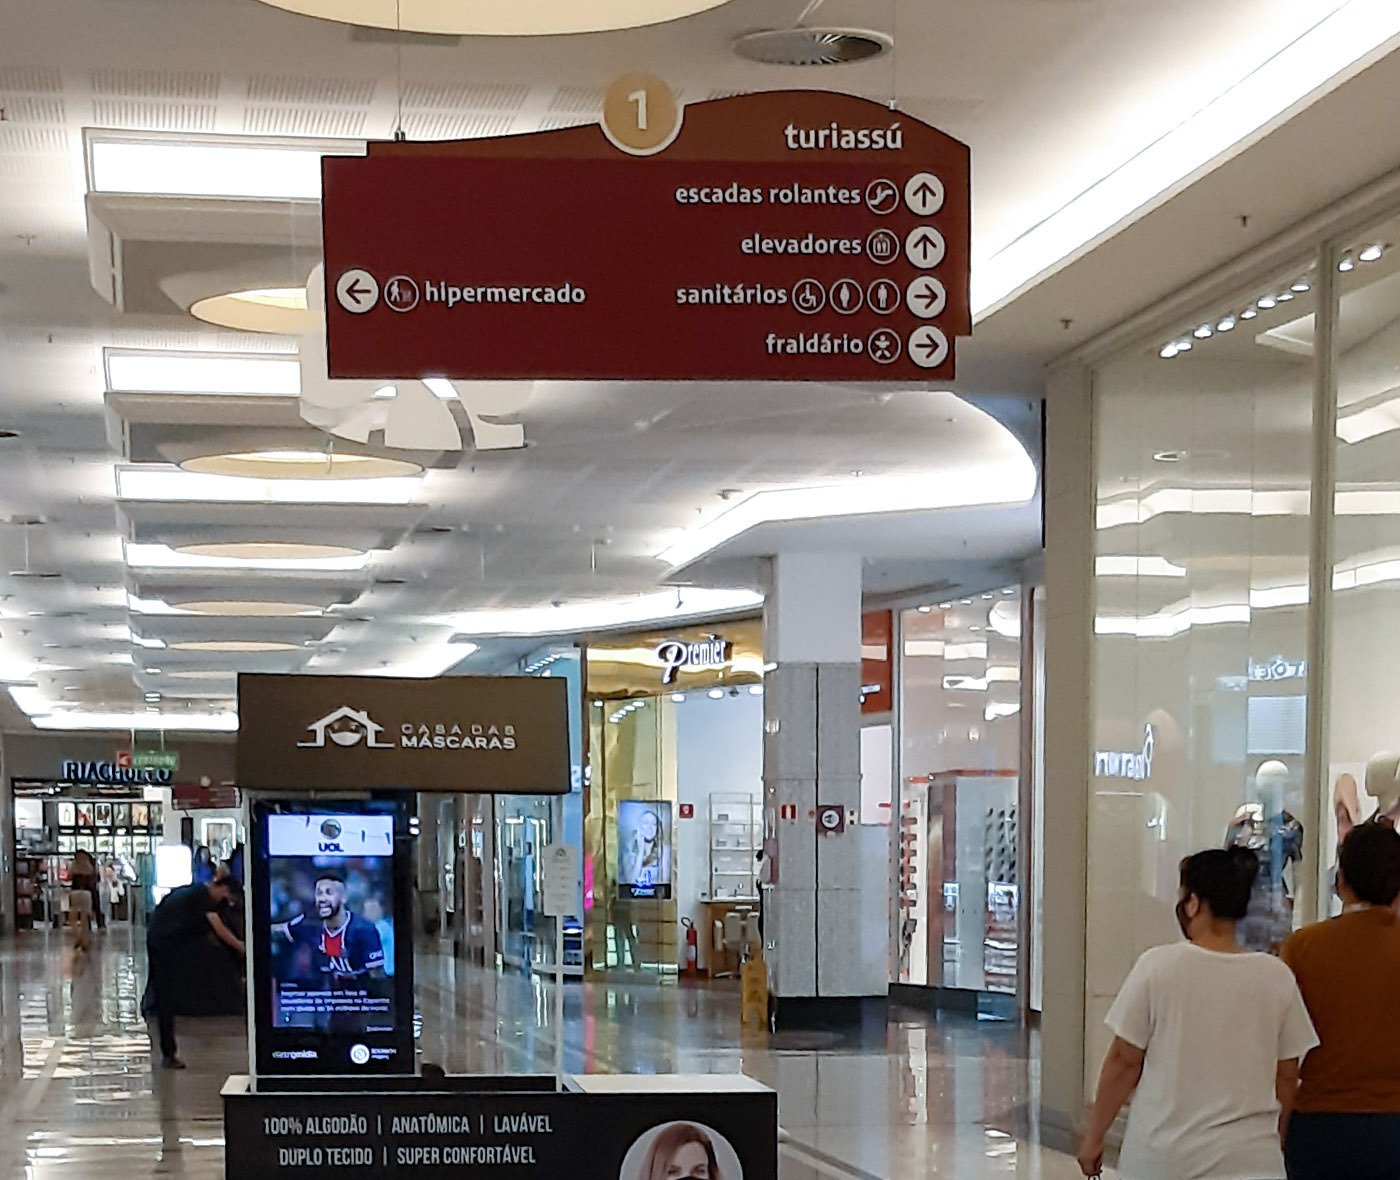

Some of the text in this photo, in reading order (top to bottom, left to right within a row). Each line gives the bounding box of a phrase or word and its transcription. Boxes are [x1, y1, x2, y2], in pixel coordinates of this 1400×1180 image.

[628, 90, 647, 130] 1
[784, 122, 902, 149] turiassú
[675, 182, 861, 204] escadas rolantes
[741, 233, 862, 254] elevadores
[425, 280, 586, 308] hipermercado
[676, 283, 788, 304] sanitários
[766, 332, 863, 354] fraldário
[655, 636, 727, 685] Premier
[401, 723, 515, 736] CASA DAS
[401, 732, 516, 749] MÁSCARAS
[318, 842, 344, 853] UOL
[264, 1112, 553, 1135] 100% ALGODÃO ANATÔMICA LAVÁVEL
[279, 1143, 536, 1166] DUPLO TECIDO SUPER CONFORTÁVEL
